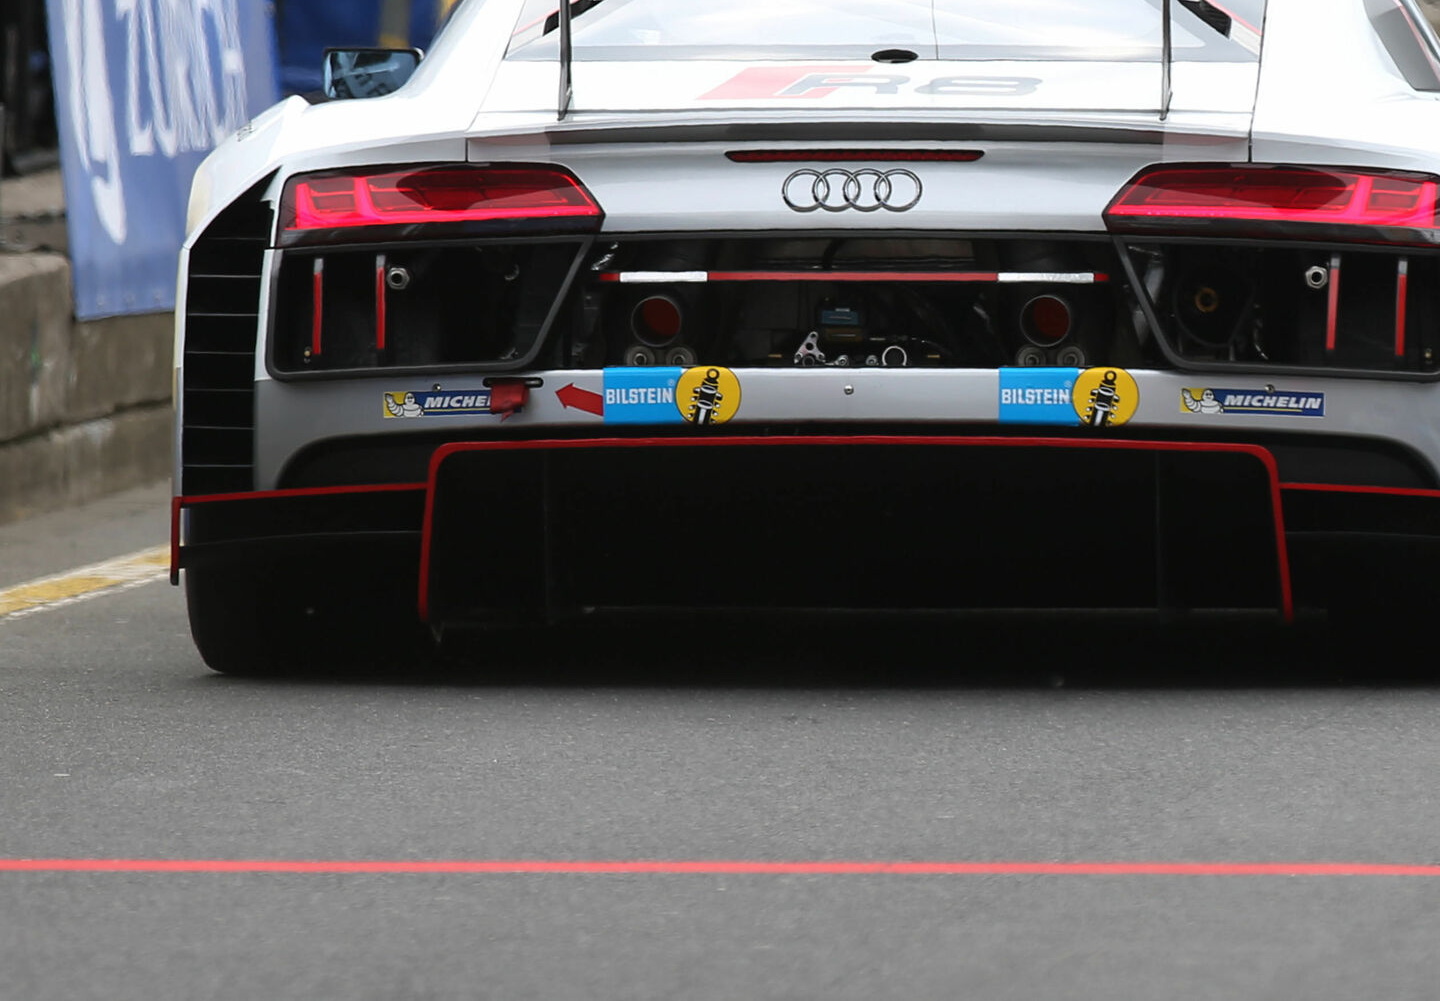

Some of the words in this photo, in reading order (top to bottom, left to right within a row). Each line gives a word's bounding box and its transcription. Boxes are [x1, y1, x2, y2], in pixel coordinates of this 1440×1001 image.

[774, 73, 1043, 97] R8
[605, 387, 674, 405] BILSTEIN
[1001, 387, 1073, 405] BILSTEIN
[1223, 394, 1322, 409] MICHELIN
